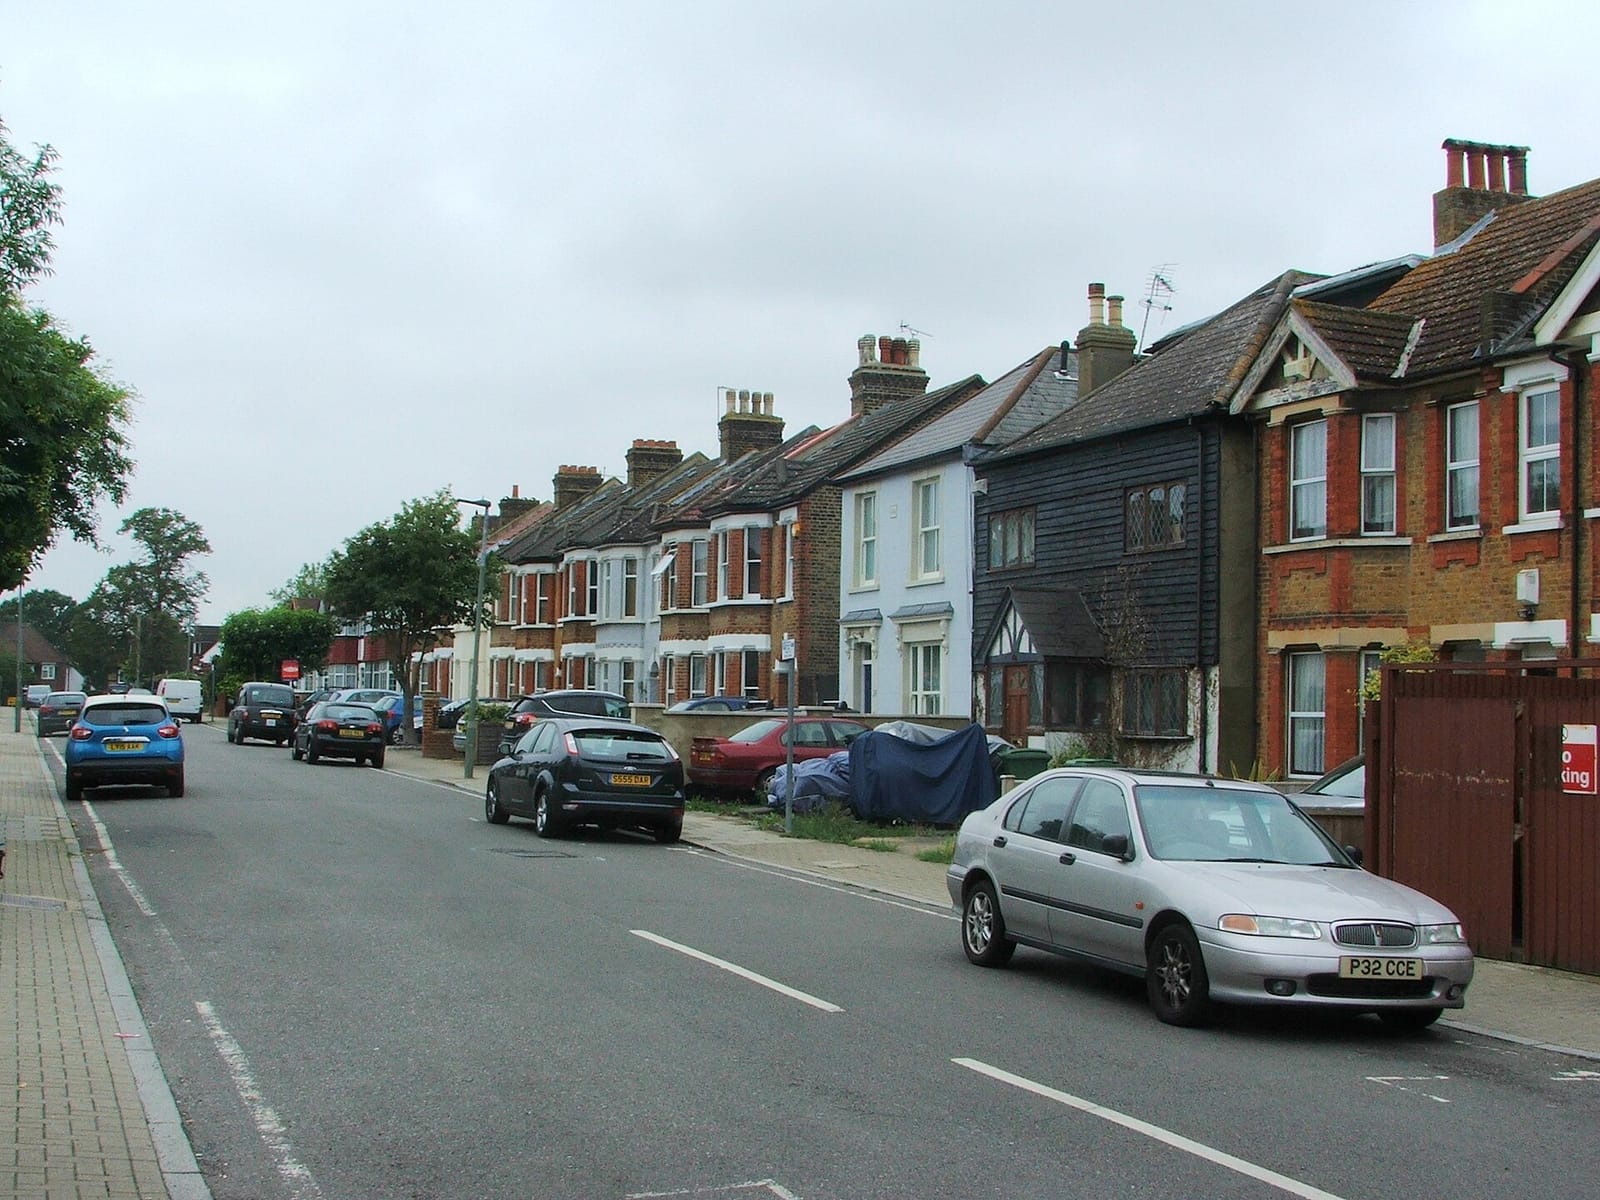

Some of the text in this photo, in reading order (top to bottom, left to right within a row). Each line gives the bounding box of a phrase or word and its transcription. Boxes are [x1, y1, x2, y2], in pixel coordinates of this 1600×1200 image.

[1561, 751, 1572, 763] o
[612, 774, 633, 783] S555
[1561, 767, 1590, 788] king
[1350, 959, 1416, 977] P32 CCE
